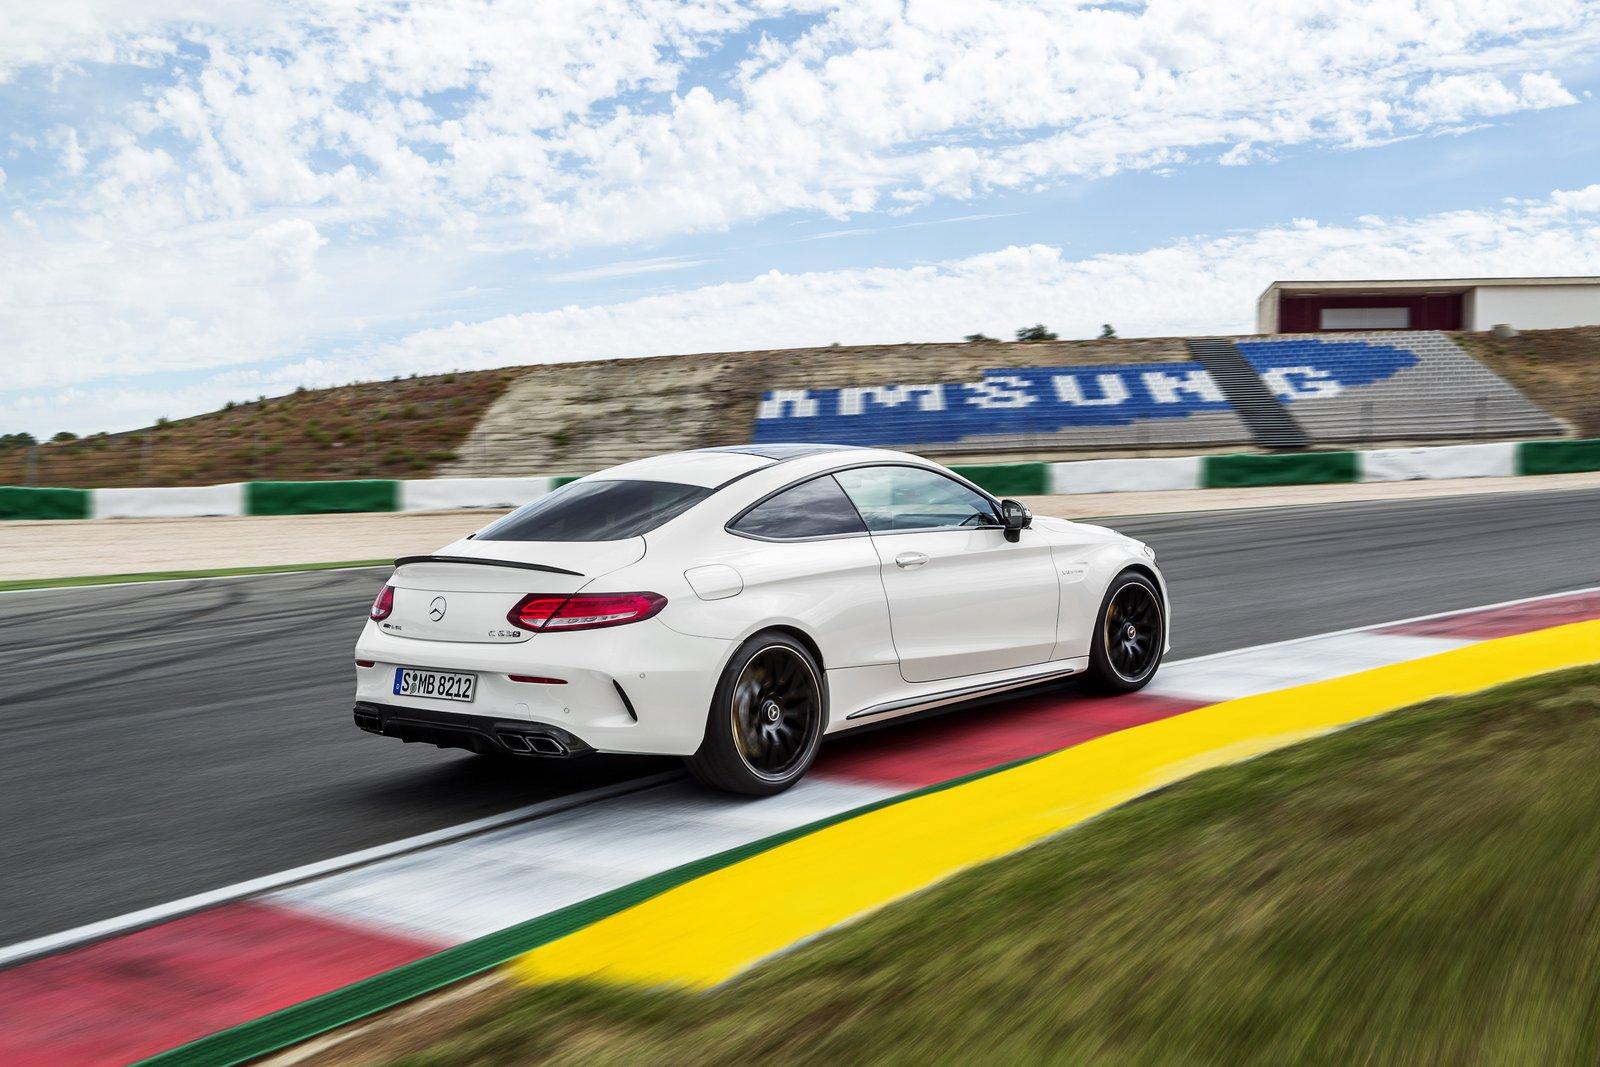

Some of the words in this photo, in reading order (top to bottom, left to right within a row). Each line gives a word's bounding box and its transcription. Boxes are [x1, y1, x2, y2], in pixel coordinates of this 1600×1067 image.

[402, 672, 411, 692] S
[417, 673, 436, 695] MB
[437, 675, 472, 699] 8212
